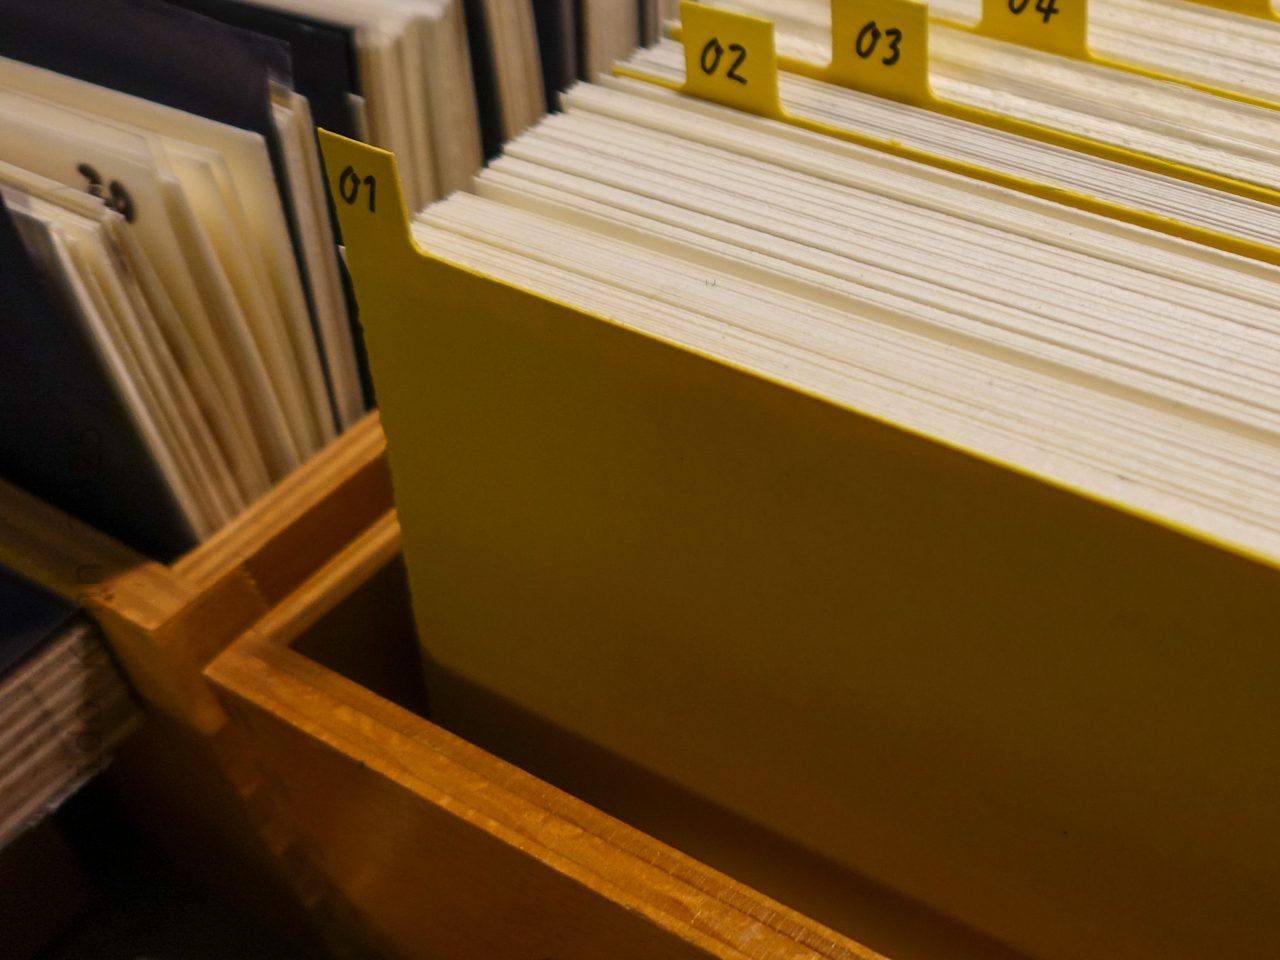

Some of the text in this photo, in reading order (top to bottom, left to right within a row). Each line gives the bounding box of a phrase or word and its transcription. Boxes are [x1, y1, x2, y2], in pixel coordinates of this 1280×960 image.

[700, 37, 748, 86] 02
[855, 20, 903, 67] 03
[338, 165, 377, 213] 01
